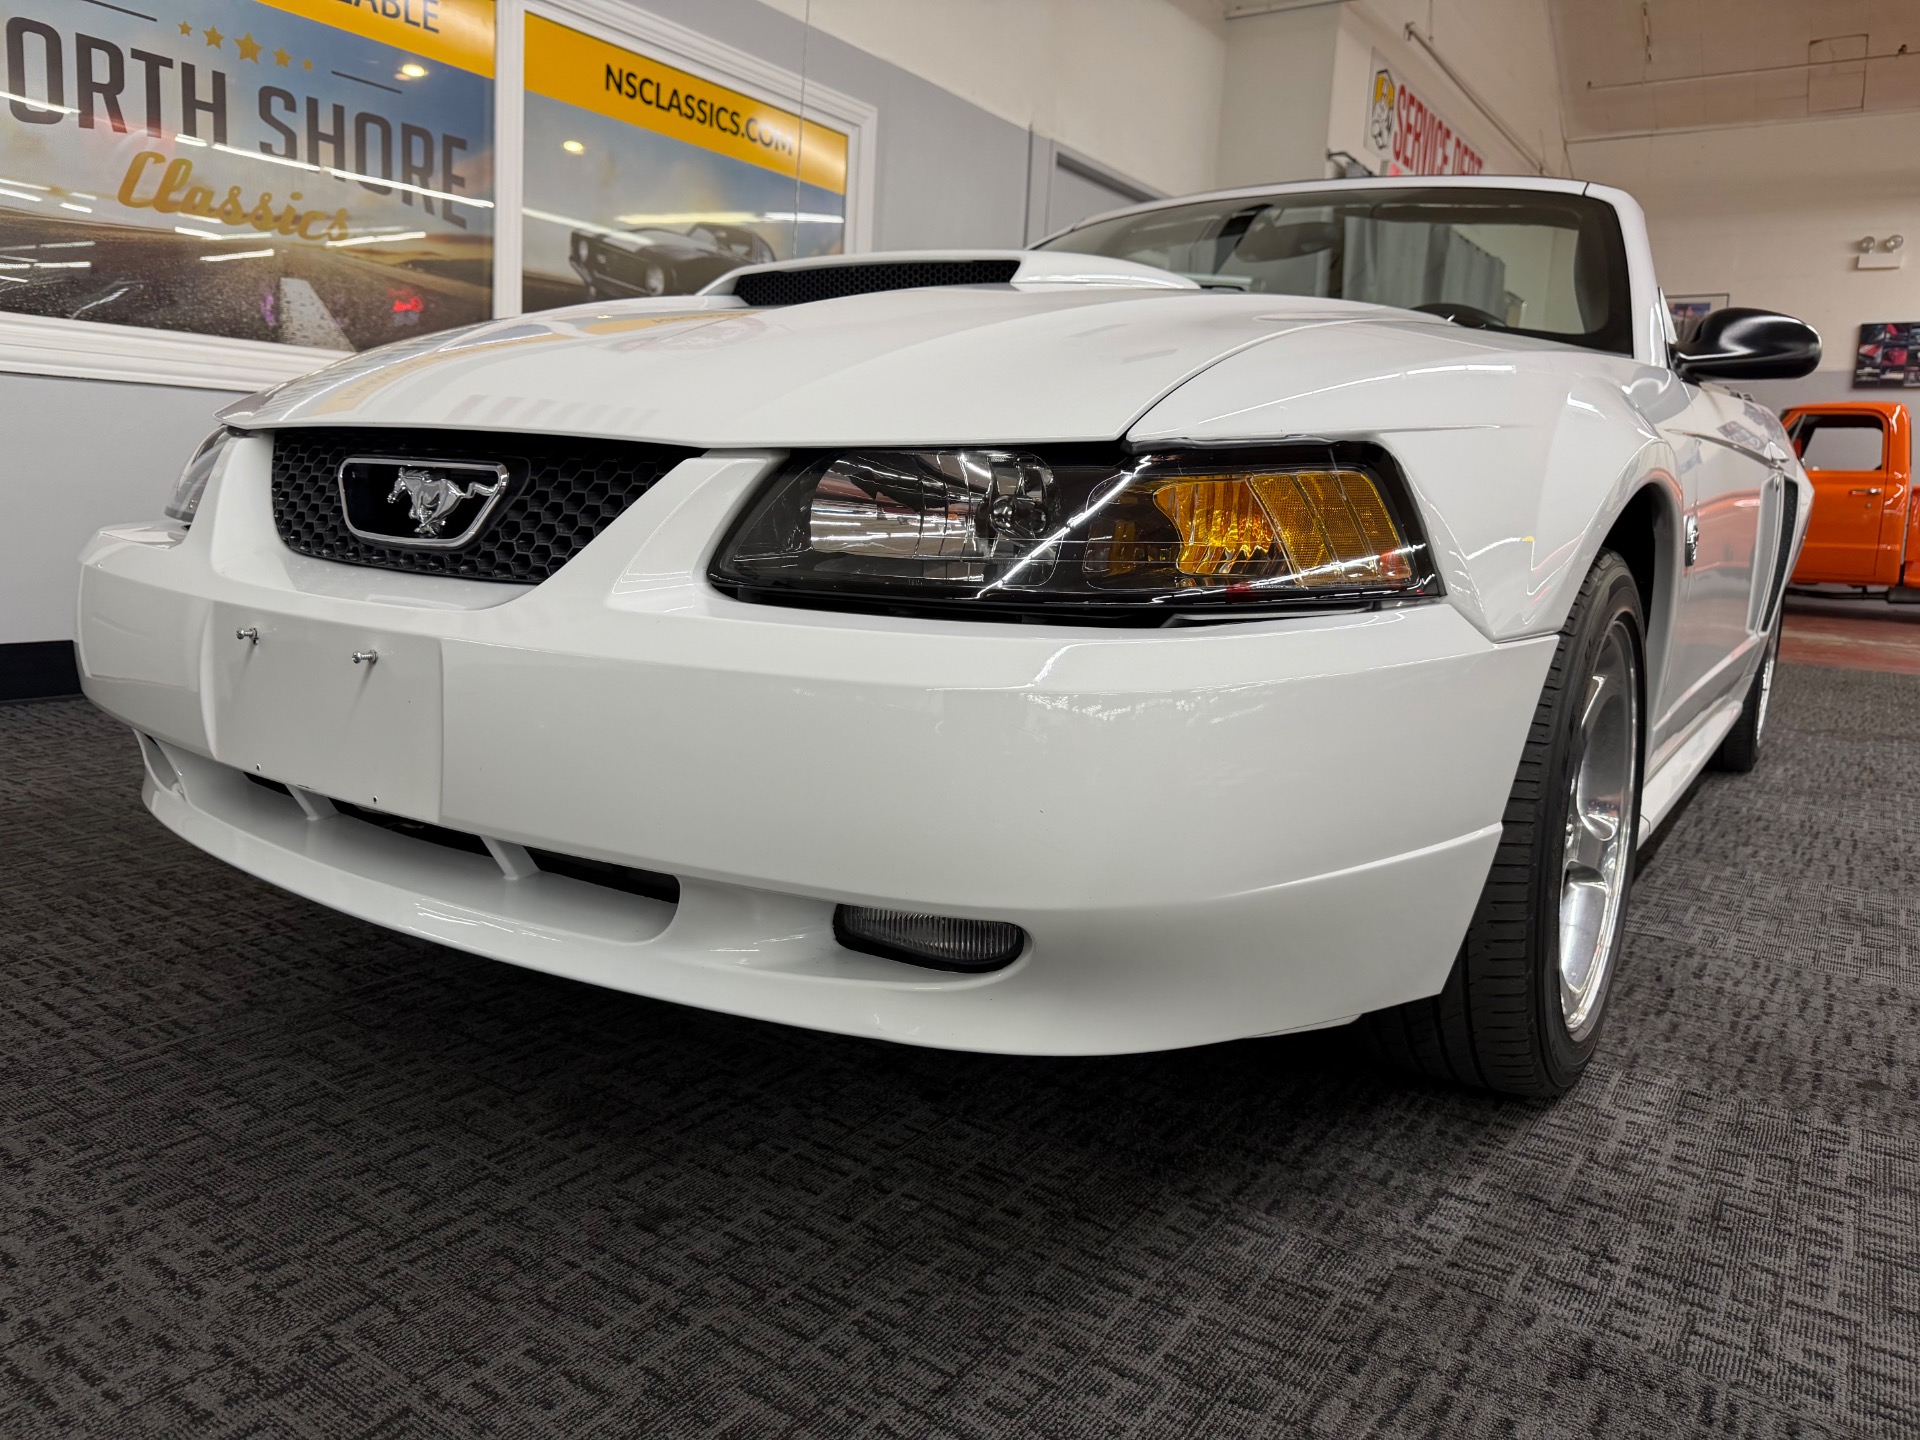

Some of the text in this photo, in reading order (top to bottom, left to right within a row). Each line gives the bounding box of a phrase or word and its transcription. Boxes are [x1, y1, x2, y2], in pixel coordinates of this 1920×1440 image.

[6, 16, 468, 230] ORTH SHORE
[604, 63, 794, 156] NSCLASSICS.COM
[1393, 84, 1484, 175] SERVICE DE
[117, 150, 350, 241] Classics
